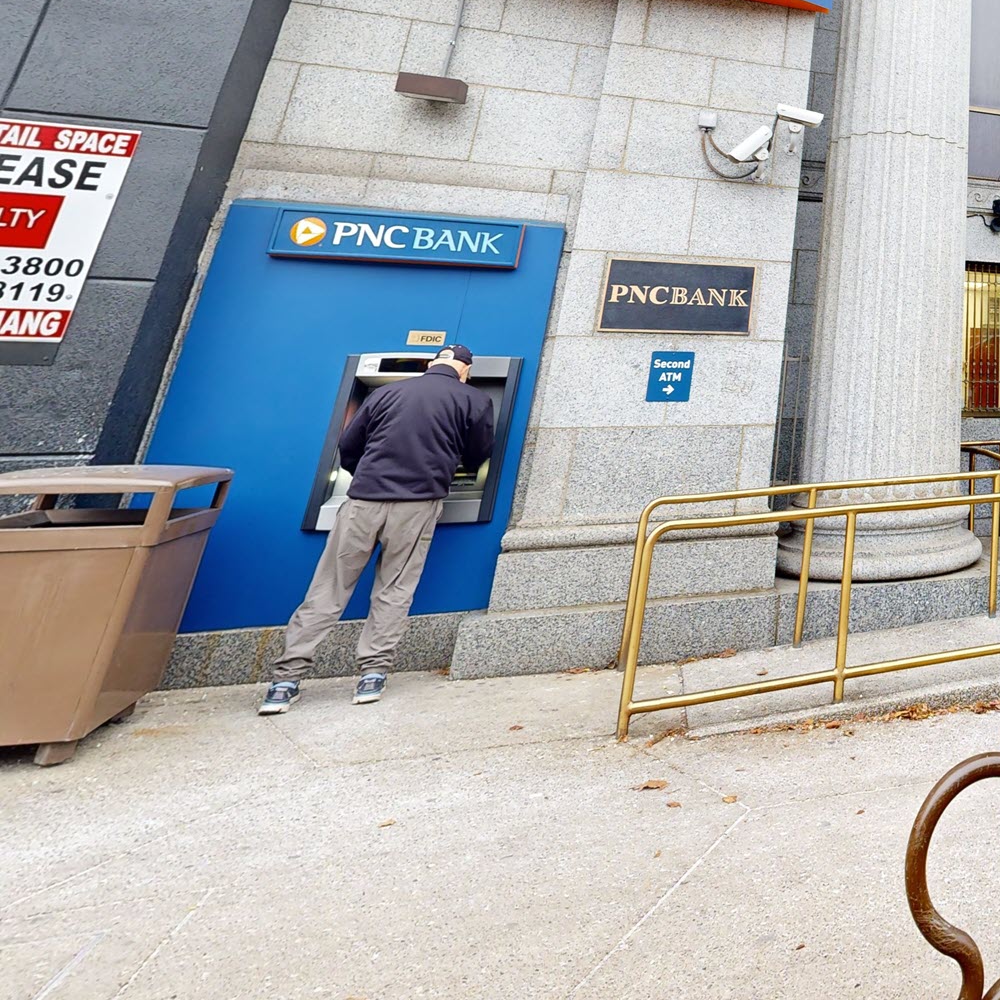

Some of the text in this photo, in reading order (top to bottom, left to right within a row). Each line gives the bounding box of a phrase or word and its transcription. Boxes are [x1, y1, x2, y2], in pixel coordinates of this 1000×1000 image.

[54, 129, 131, 154] SPACE
[0, 153, 107, 191] EASE
[333, 221, 504, 254] PNC BANK
[1, 255, 84, 277] 3800
[653, 358, 691, 369] Second
[659, 372, 682, 382] ATM
